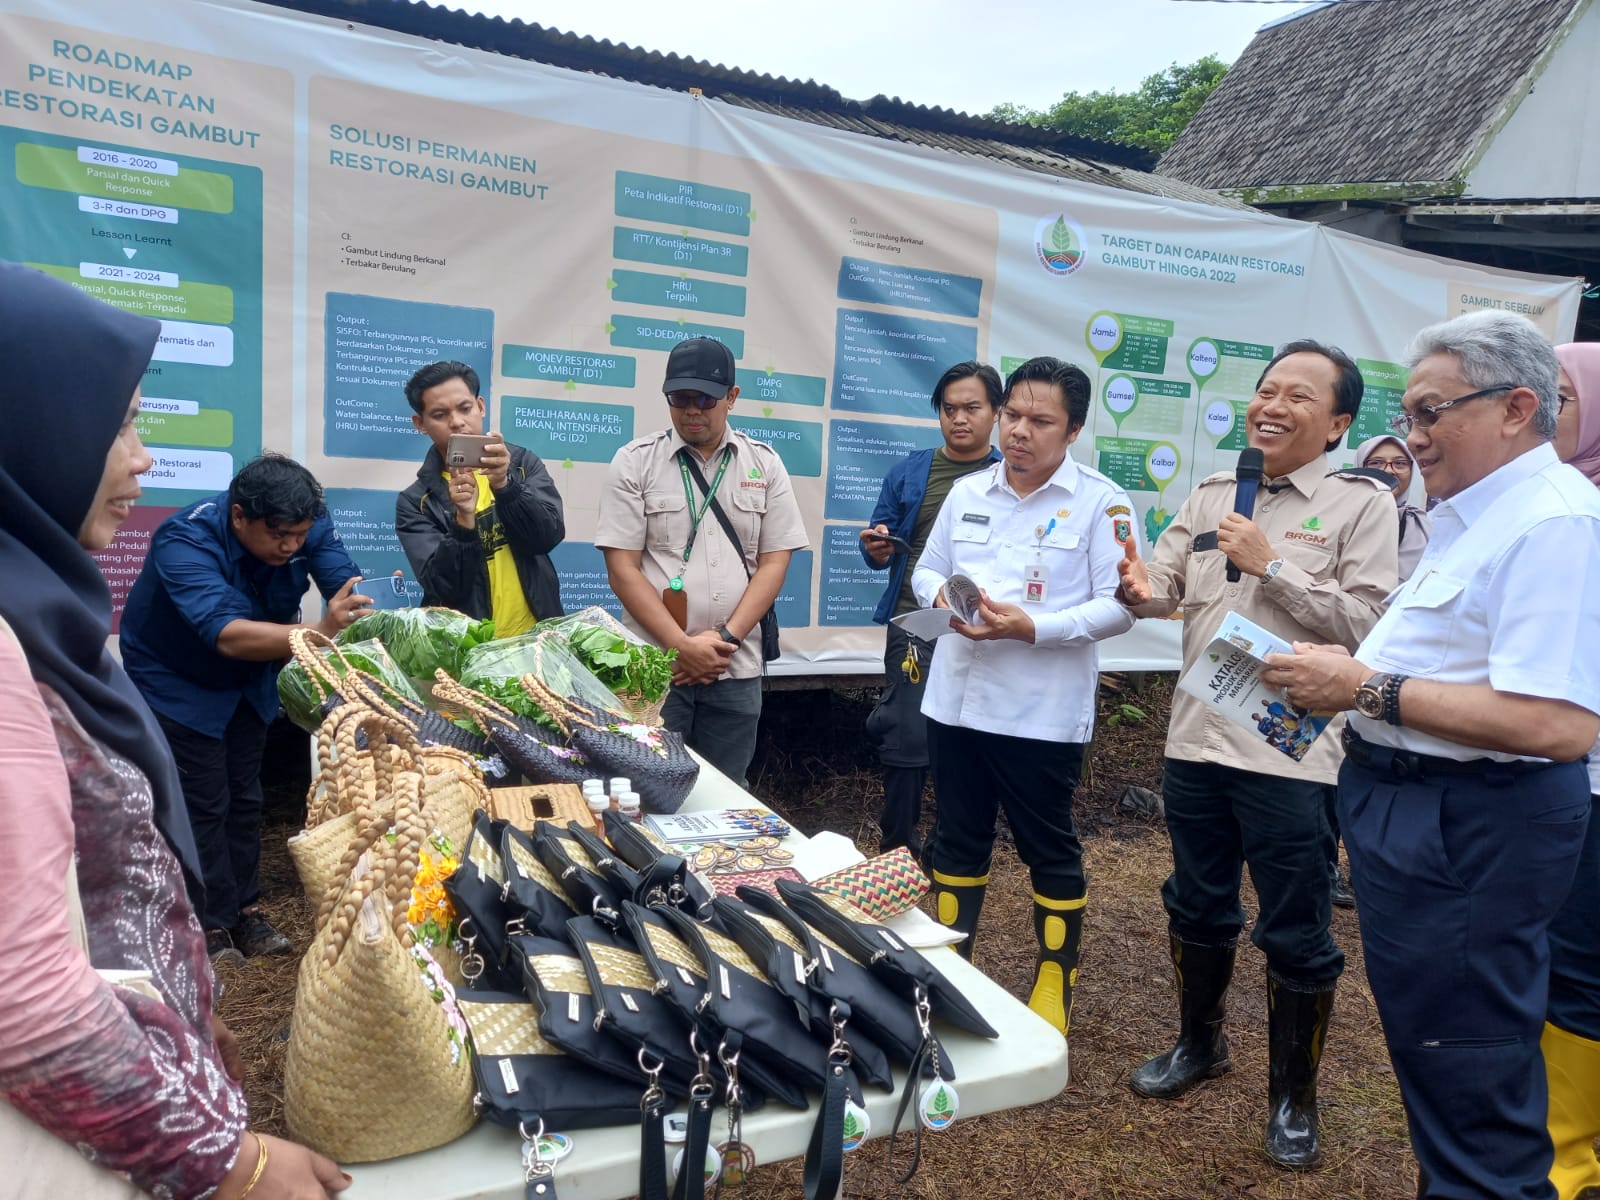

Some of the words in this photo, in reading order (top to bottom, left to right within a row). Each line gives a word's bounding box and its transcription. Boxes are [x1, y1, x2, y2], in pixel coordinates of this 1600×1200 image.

[52, 39, 193, 81] ROADMAP
[28, 63, 215, 114] PENDEKATAN
[0, 88, 142, 130] ESTORASI
[150, 115, 261, 149] GAMBUT
[330, 124, 411, 152] SOLUSI
[418, 140, 537, 174] PERMANEN
[93, 151, 118, 164] 2016
[129, 157, 157, 170] 2020
[86, 167, 119, 181] Parsial
[121, 171, 140, 184] dan
[142, 174, 170, 188] Quick
[330, 149, 454, 184] RESTORASI
[461, 172, 549, 200] GAMBUT
[105, 181, 153, 197] Response
[679, 185, 693, 195] PIR
[624, 187, 645, 199] Peta
[647, 190, 684, 204] Indikatif
[685, 197, 723, 212] Restorasi
[725, 204, 743, 217] (D1)
[93, 201, 113, 213] 3-R
[116, 204, 138, 216] dan
[141, 206, 166, 219] DPG
[91, 228, 131, 241] Lesson
[135, 233, 172, 246] Learnt
[633, 233, 654, 244] RTT/
[656, 236, 699, 251] Kontijensi
[701, 244, 719, 254] Plan
[721, 248, 731, 256] 3R
[346, 245, 378, 257] Gambut
[380, 250, 412, 263] Lindung
[414, 254, 446, 266] Berkanal
[674, 251, 692, 262] (D1)
[1101, 234, 1152, 253] TARGET
[1155, 242, 1181, 258] DAN
[1184, 247, 1239, 266] CAPAIAN
[1242, 257, 1305, 277] RESTORASI
[346, 258, 380, 269] Terbakar
[382, 262, 416, 275] Berulang
[1102, 252, 1155, 271] GAMBUT
[1159, 261, 1207, 279] HINGGA
[1209, 269, 1236, 284] 2022
[99, 266, 123, 278] 2021
[134, 271, 161, 283] 2024
[672, 281, 691, 291] HRU
[108, 286, 137, 298] Quick
[138, 289, 187, 304] Response,
[665, 291, 697, 303] Terpilih
[1461, 294, 1501, 309] GAMBUT
[336, 314, 365, 326] Output
[364, 330, 419, 343] Terbangunnya
[437, 338, 472, 347] koordinat
[1092, 327, 1116, 338] Jambi
[197, 334, 215, 349] dan
[336, 339, 384, 350] berdasarkan
[386, 344, 423, 354] Dokumen
[425, 348, 438, 356] SID
[336, 351, 393, 363] Terbangunnya
[395, 356, 408, 364] IPG
[525, 352, 563, 363] MONEV
[566, 356, 615, 368] RESTORASI
[1190, 353, 1217, 365] Kalteng
[336, 362, 373, 373] Kontruksi
[539, 365, 581, 376] GAMBUT
[584, 368, 602, 379] (D1)
[335, 375, 360, 384] sesuai
[361, 377, 400, 387] Dokumen
[757, 378, 782, 388] DMPG
[761, 388, 777, 398] (D3)
[1107, 391, 1134, 401] Sumsel
[138, 400, 180, 412] terusnya
[335, 398, 374, 409] OutCome
[147, 416, 165, 425] dan
[335, 410, 359, 420] Water
[361, 411, 393, 422] balance,
[516, 407, 590, 422] PEMELIHARAAN
[593, 414, 599, 422] &
[602, 415, 622, 424] PER-
[1208, 413, 1229, 422] Kalsel
[335, 422, 358, 432] (HRU)
[359, 424, 392, 433] berbasis
[394, 427, 418, 435] neraca
[516, 420, 554, 431] BAIKAN,
[557, 423, 621, 435] INTENSIFIKASI
[550, 432, 565, 441] IPG
[569, 434, 587, 444] (D2)
[788, 431, 800, 441] IPG
[160, 458, 201, 469] Restorasi
[1151, 457, 1175, 468] Kalbar
[141, 467, 176, 479] erpadu
[333, 509, 362, 517] Output
[113, 529, 150, 540] Gambut
[359, 533, 376, 541] baik,
[1285, 531, 1327, 545] BRGM
[118, 541, 149, 552] Peduli
[1213, 675, 1238, 704] PRODUK
